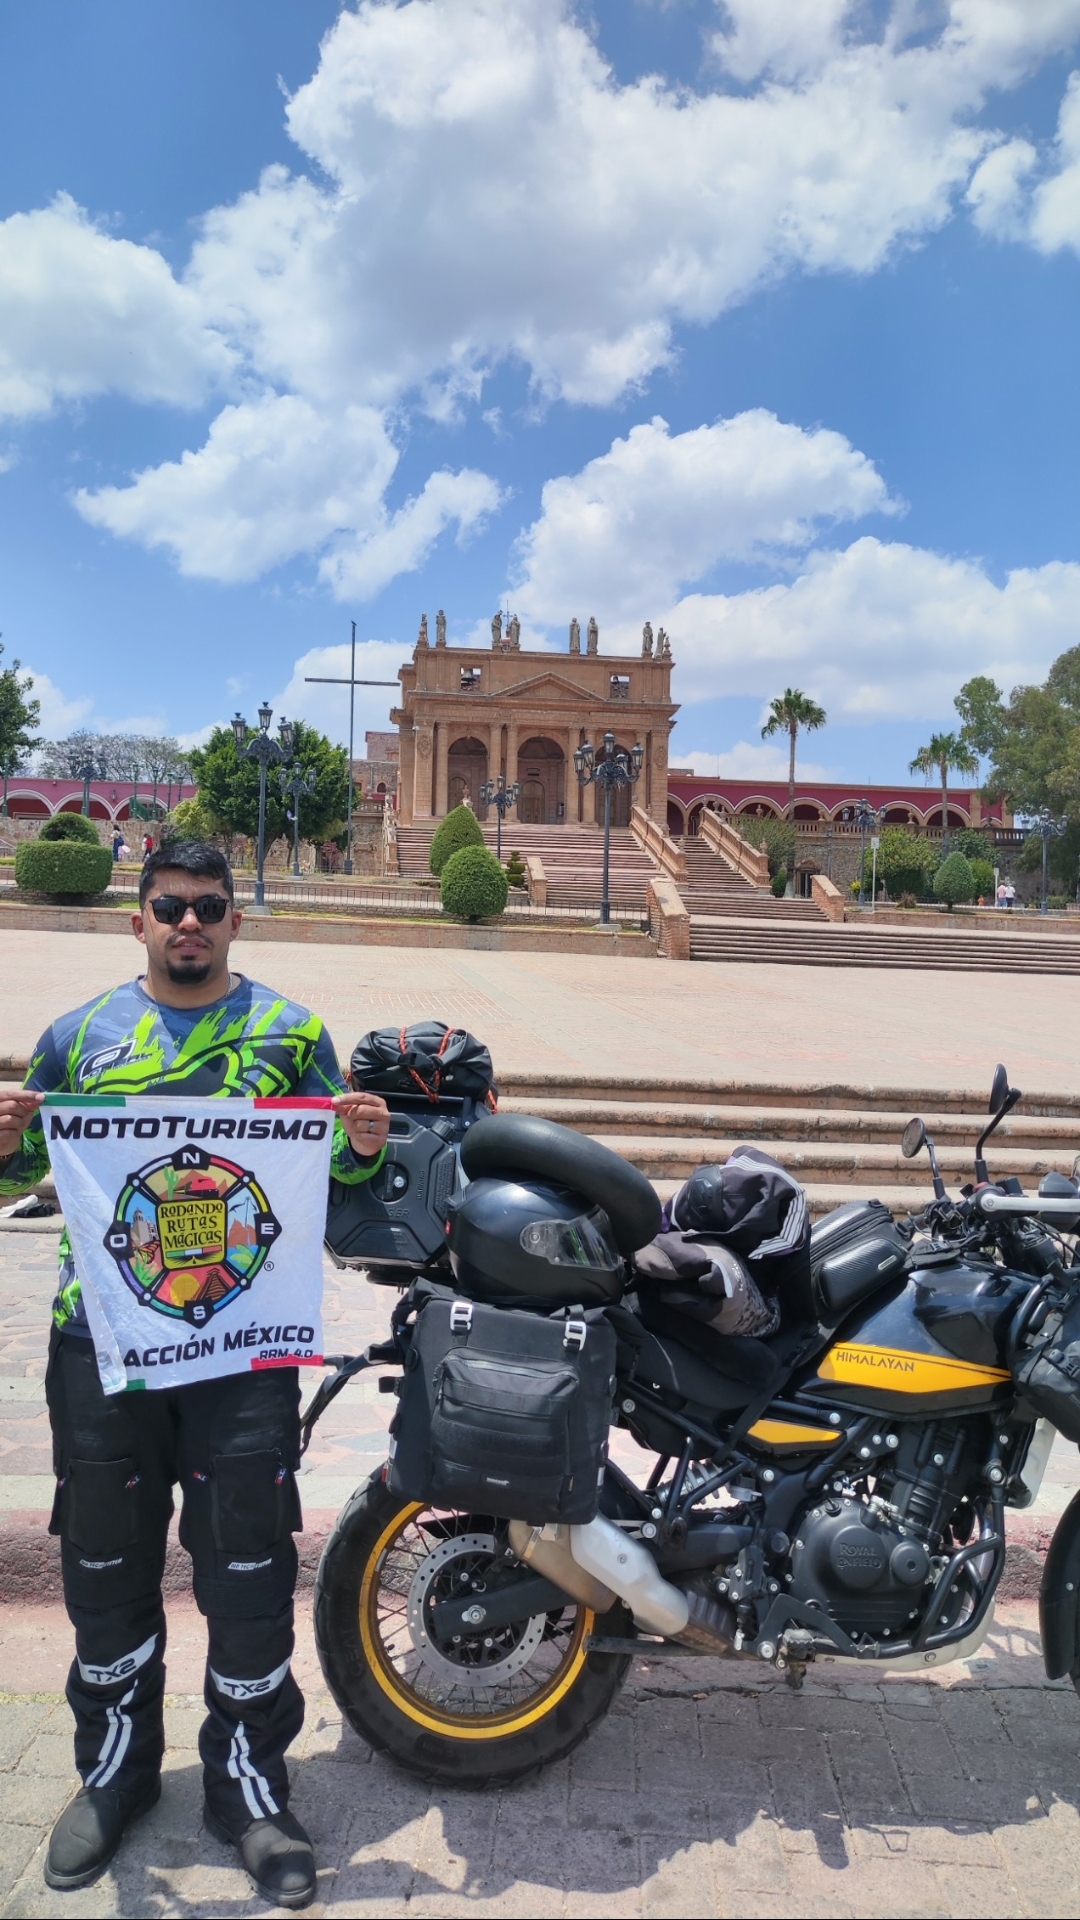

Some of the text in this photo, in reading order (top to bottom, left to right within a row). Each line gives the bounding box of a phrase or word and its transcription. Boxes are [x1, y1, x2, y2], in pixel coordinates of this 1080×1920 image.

[182, 1152, 200, 1164] N
[261, 1222, 275, 1235] E
[193, 1305, 206, 1320] S
[123, 1321, 315, 1367] ACCIÓN MÉXICO
[259, 1348, 314, 1360] RRM 4.0
[836, 1351, 915, 1372] HIMALAYAN
[840, 1543, 877, 1557] ROYAL
[88, 1658, 136, 1682] TX2
[223, 1679, 271, 1697] TX2
